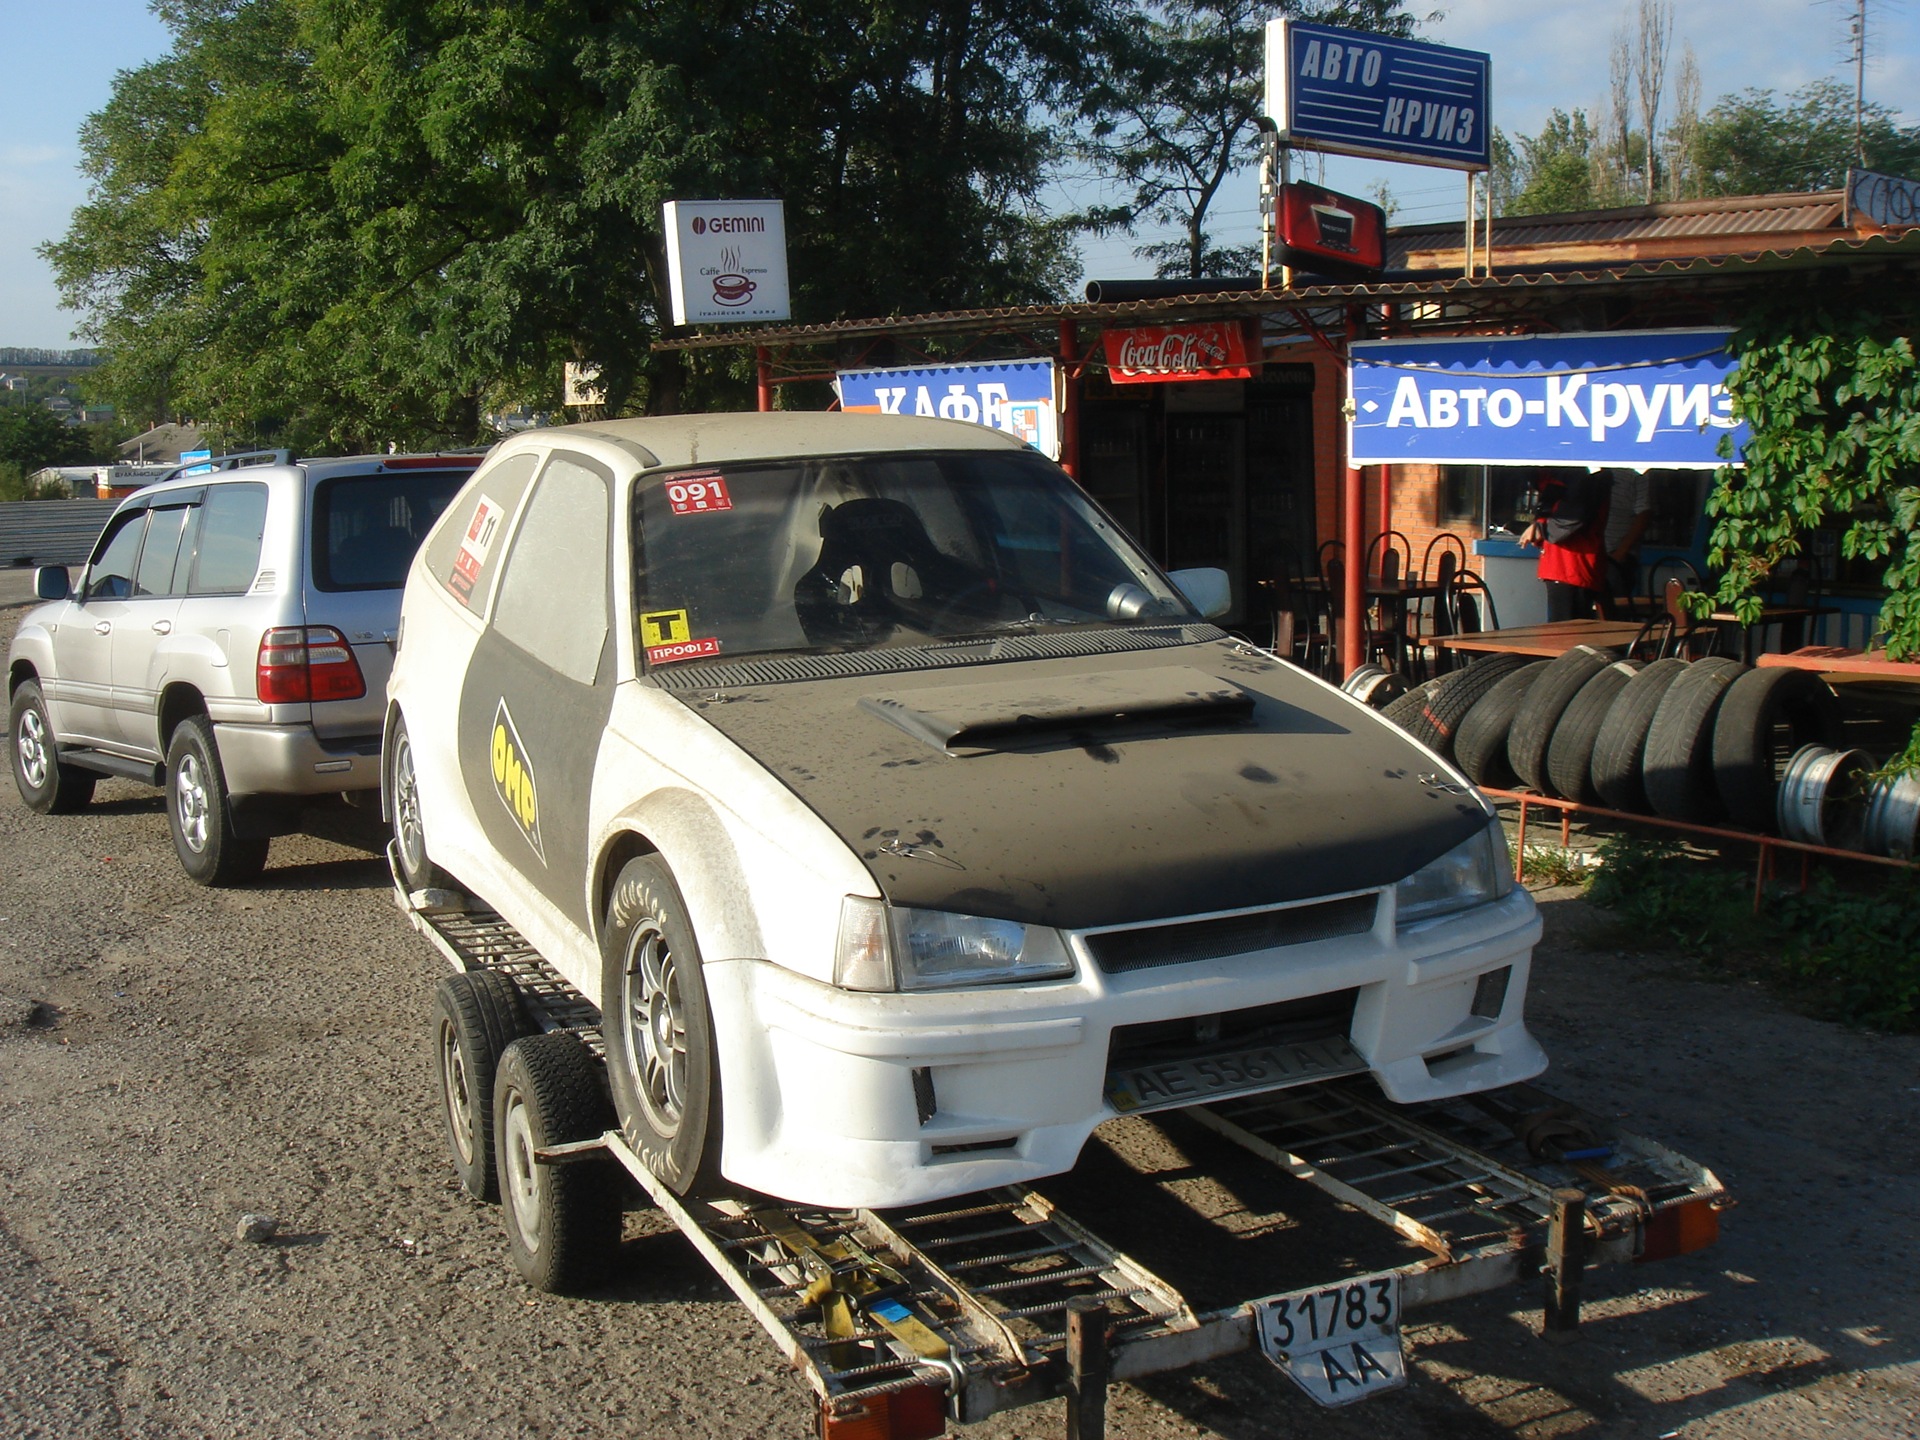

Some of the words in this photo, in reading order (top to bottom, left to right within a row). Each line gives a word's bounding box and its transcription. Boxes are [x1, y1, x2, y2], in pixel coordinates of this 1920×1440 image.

[1300, 39, 1383, 88] АВТО
[1382, 96, 1475, 144] КРУИЗ
[709, 217, 765, 233] GEMINI
[700, 267, 720, 276] Caffe
[741, 266, 768, 275] Espresso
[1120, 333, 1200, 377] Coca-Cola
[1386, 373, 1743, 443] Авто-Круиз
[669, 481, 723, 503] 091
[646, 613, 681, 641] T
[653, 643, 702, 659] ПРОФІ
[704, 641, 714, 651] 2
[493, 724, 536, 831] OMP
[1131, 1066, 1198, 1101] AE
[1193, 1050, 1291, 1088] 5561
[1268, 1277, 1392, 1348] 31783
[1320, 1341, 1392, 1394] AA
